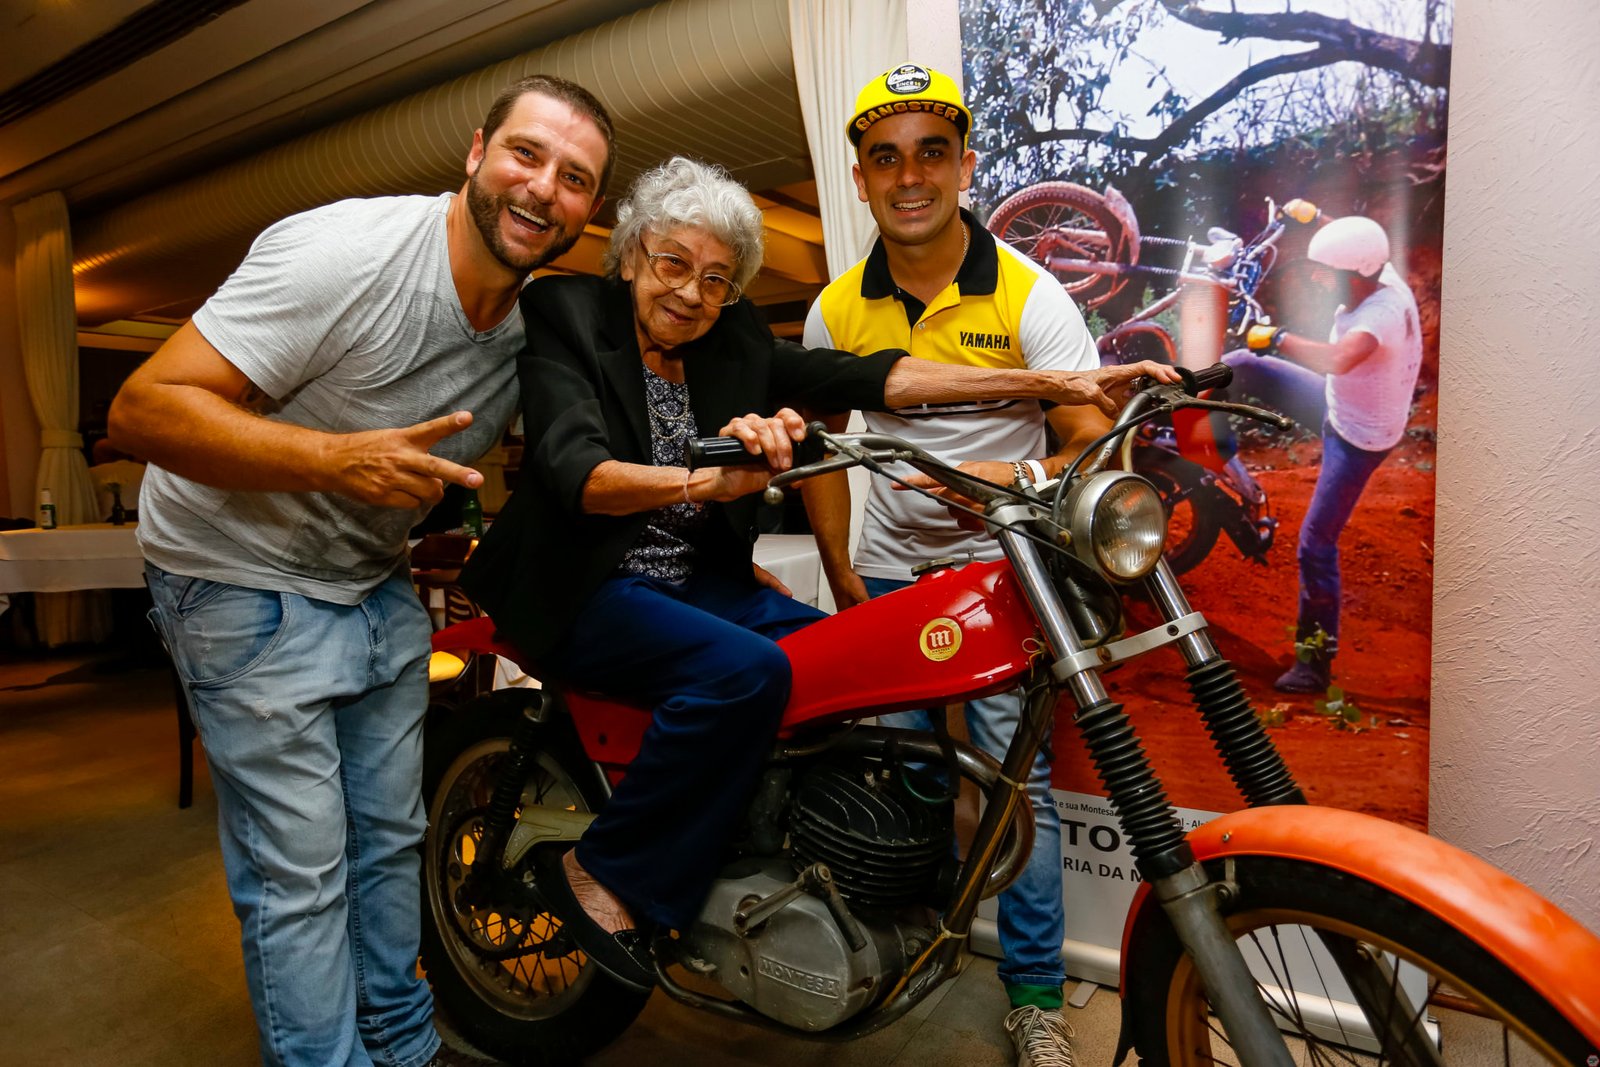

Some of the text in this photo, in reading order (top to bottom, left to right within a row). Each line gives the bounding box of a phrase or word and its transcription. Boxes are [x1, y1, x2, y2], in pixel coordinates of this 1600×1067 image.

[855, 101, 959, 131] GANGSTER
[960, 331, 1010, 350] YAMAHA
[1065, 802, 1079, 810] sua
[1080, 803, 1114, 817] Montesa
[1099, 864, 1124, 880] DA
[762, 958, 838, 996] MONTESA
